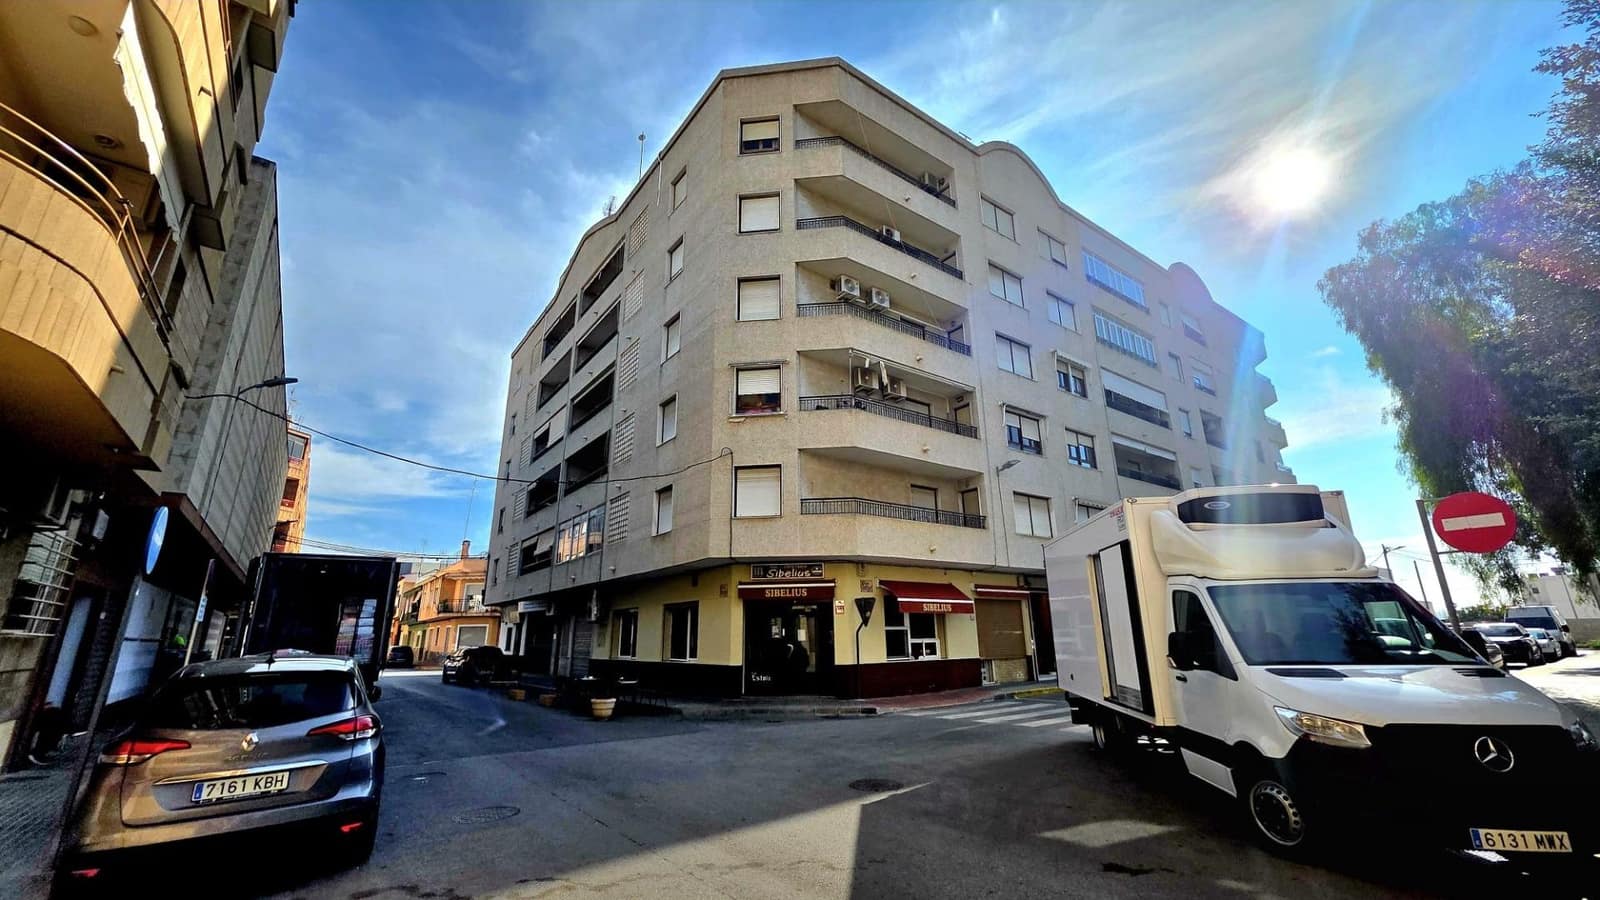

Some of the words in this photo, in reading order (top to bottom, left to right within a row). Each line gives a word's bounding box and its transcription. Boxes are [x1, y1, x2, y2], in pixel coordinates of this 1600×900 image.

[766, 568, 811, 578] Sibelius
[765, 588, 808, 598] SIBELIUS
[922, 603, 952, 612] SIBELIUS
[206, 780, 247, 797] 7161
[253, 774, 284, 790] KBH
[1484, 832, 1529, 849] 6131
[1534, 834, 1568, 850] MWX
